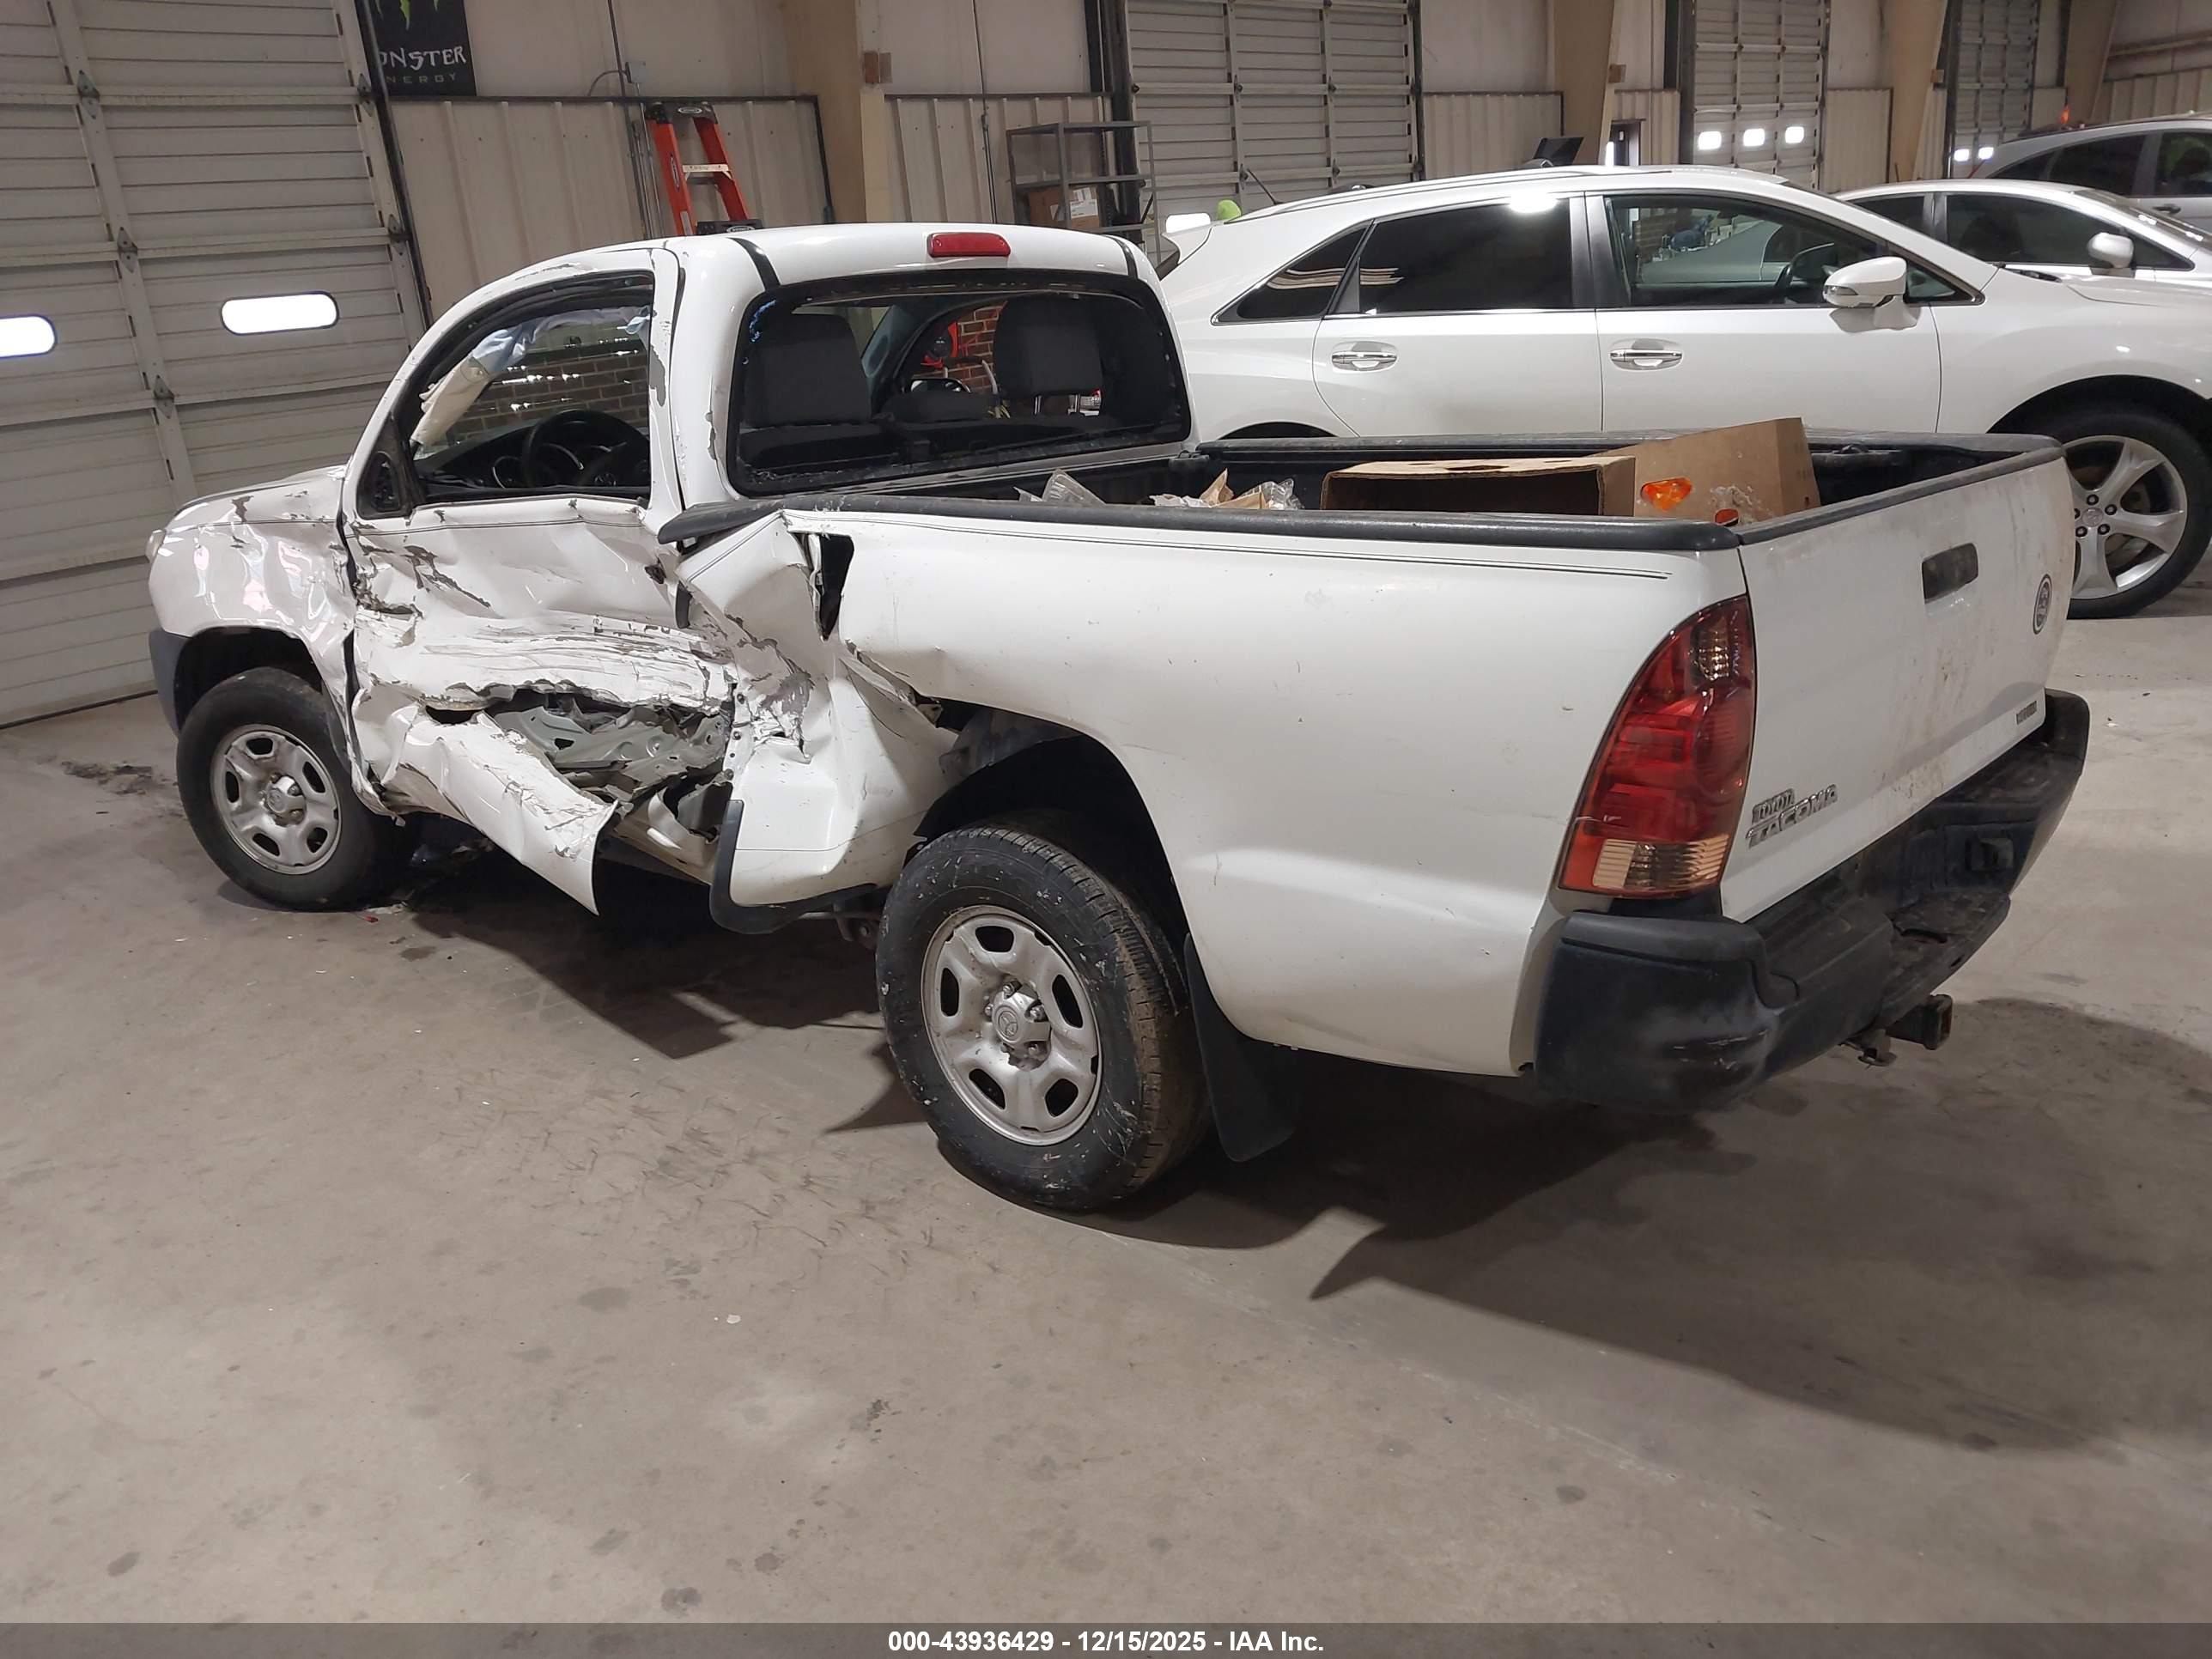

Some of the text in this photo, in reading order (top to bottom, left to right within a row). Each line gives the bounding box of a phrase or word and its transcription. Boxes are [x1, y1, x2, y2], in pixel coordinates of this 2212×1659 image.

[379, 46, 467, 70] ONSTER
[386, 72, 457, 84] NERGY
[1745, 784, 1838, 848] TACOMA
